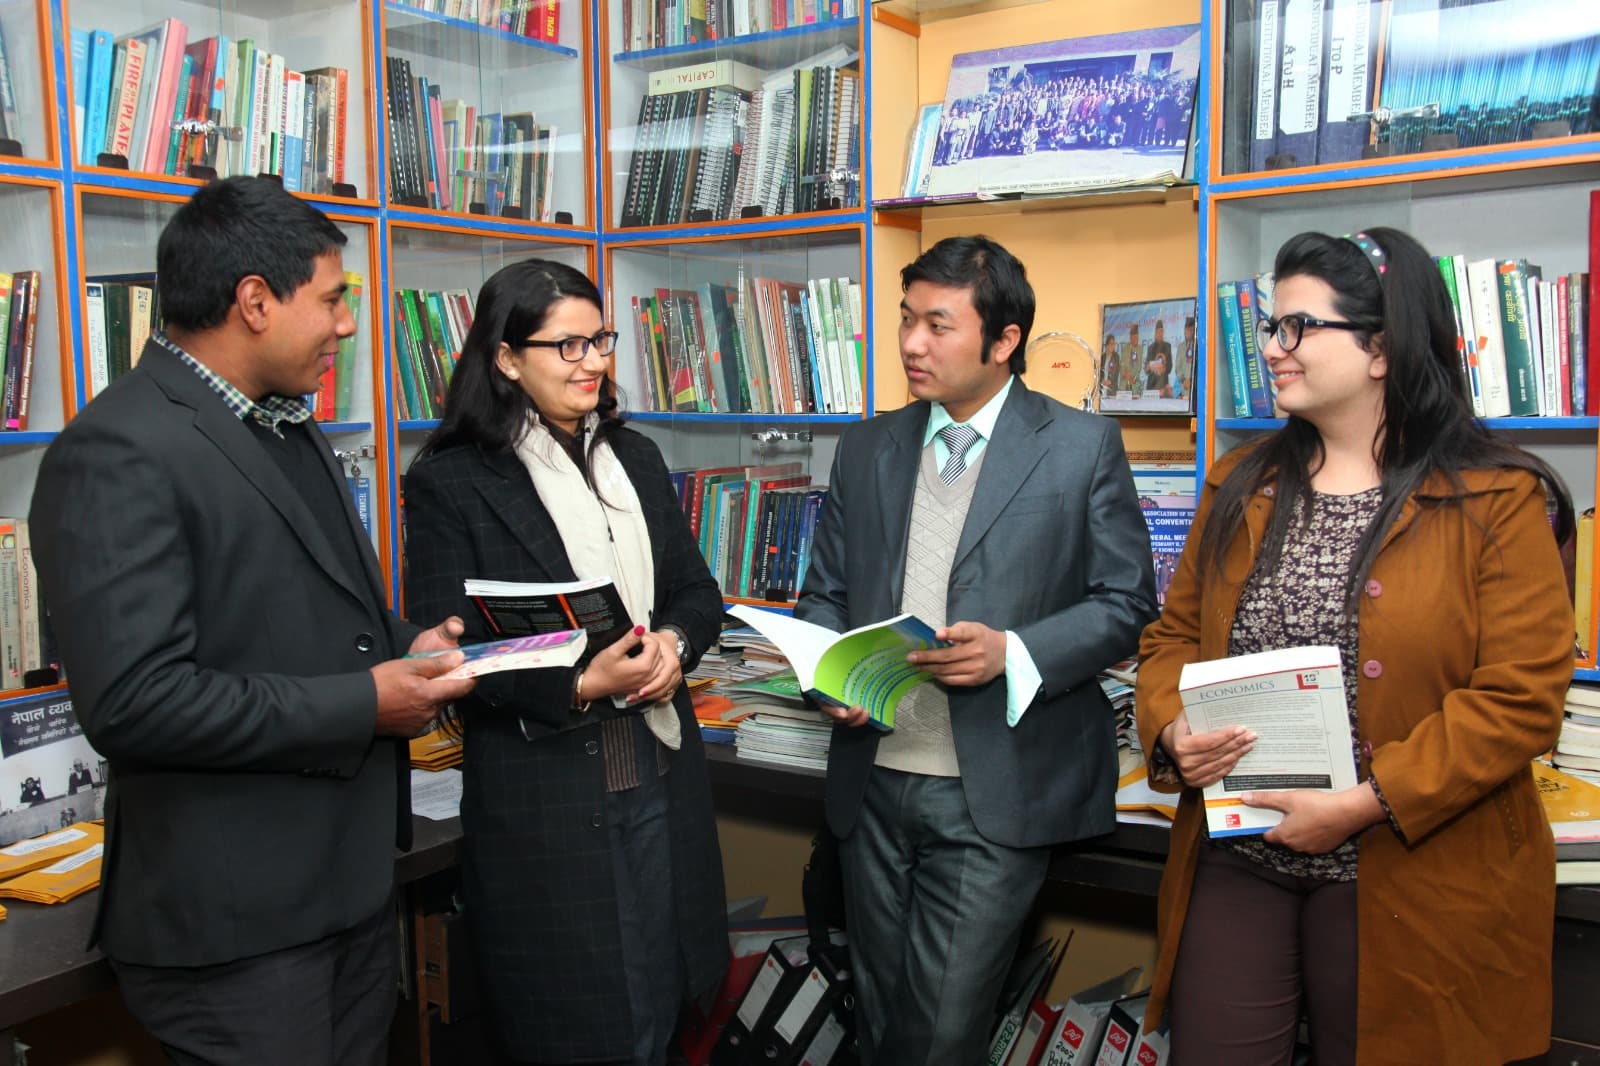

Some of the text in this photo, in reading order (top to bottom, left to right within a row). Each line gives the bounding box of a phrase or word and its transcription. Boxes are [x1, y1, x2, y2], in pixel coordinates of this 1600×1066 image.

[1284, 44, 1297, 55] A
[126, 54, 143, 89] FIRE
[1303, 0, 1322, 129] NDIVIDUAL MEMBER
[1331, 65, 1344, 75] P
[677, 69, 715, 83] CAPITAL
[1282, 79, 1295, 89] H
[1258, 87, 1273, 137] MEMBER
[1241, 308, 1259, 389] DIGITAL MARKETING
[21, 547, 30, 610] Economics
[1199, 680, 1275, 700] ECONOMICS
[11, 700, 73, 725] नेपाल व्यव
[1055, 1041, 1075, 1060] 2007
